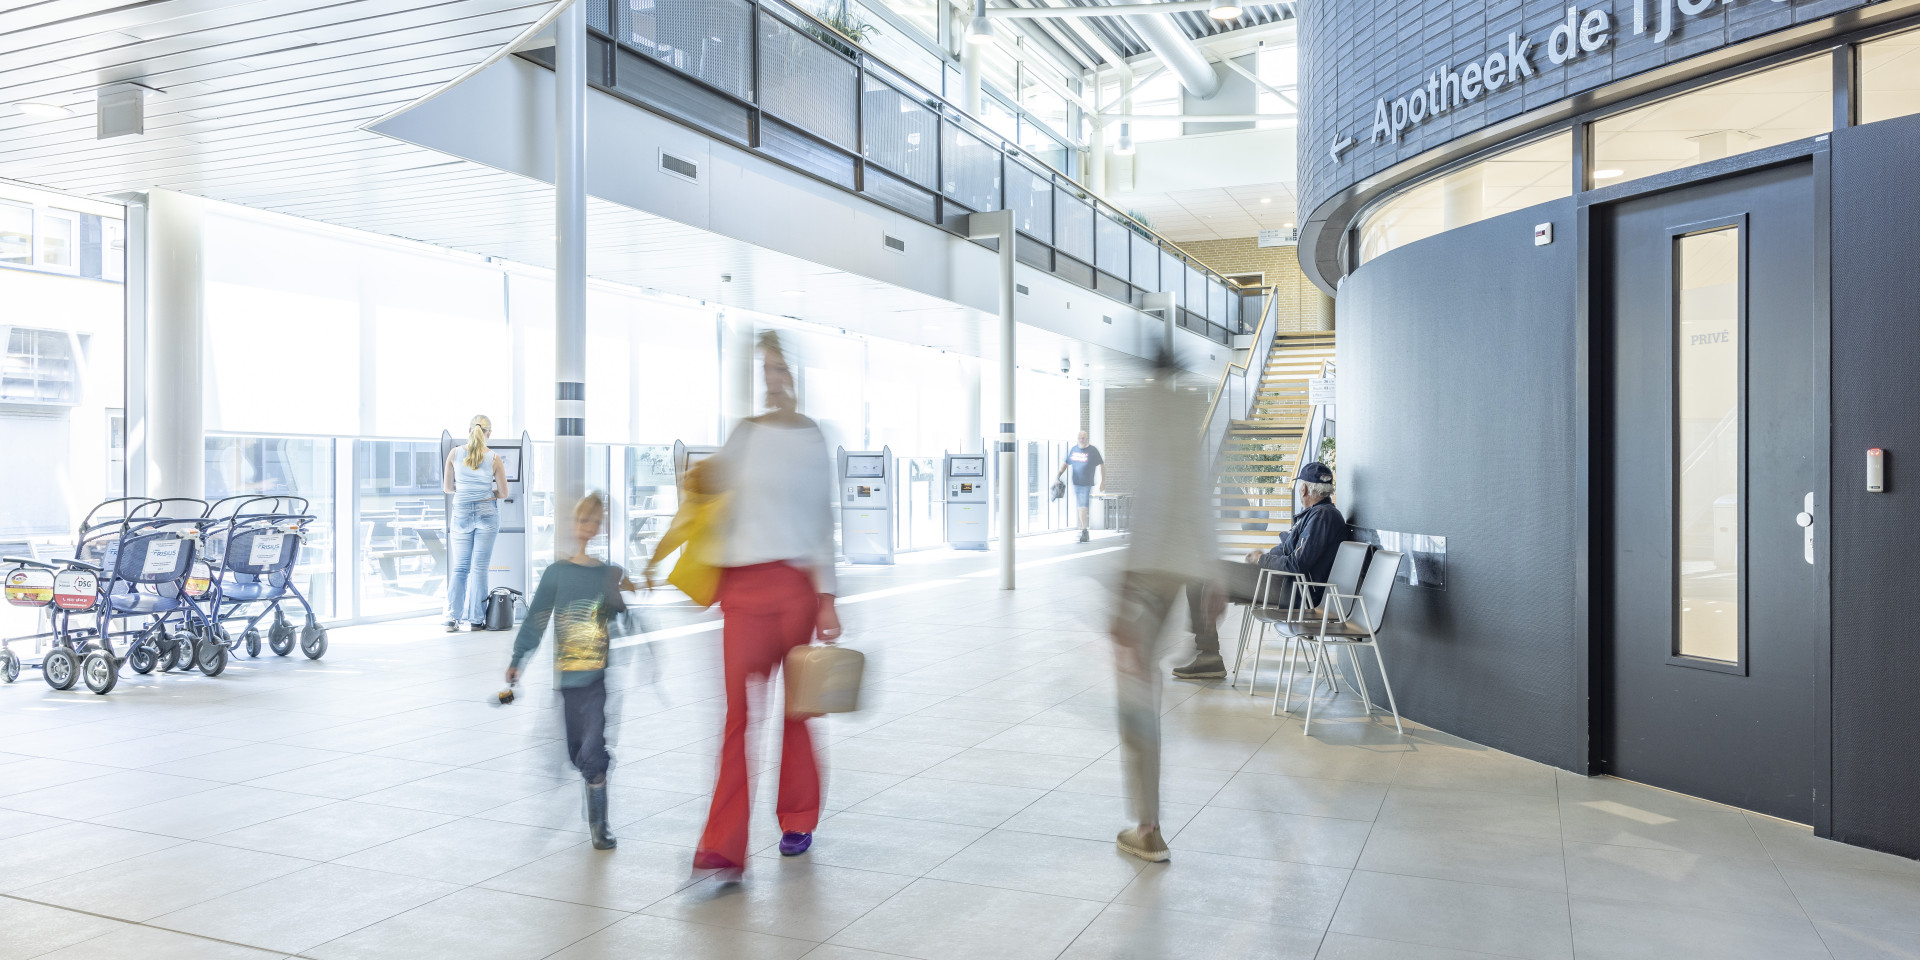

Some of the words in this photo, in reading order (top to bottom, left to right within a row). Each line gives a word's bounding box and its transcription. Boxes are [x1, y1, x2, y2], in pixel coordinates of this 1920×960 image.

[1371, 31, 1532, 144] Apotheek
[1548, 6, 1609, 64] de
[1691, 329, 1729, 345] PRIVÉ
[78, 580, 92, 588] DSG
